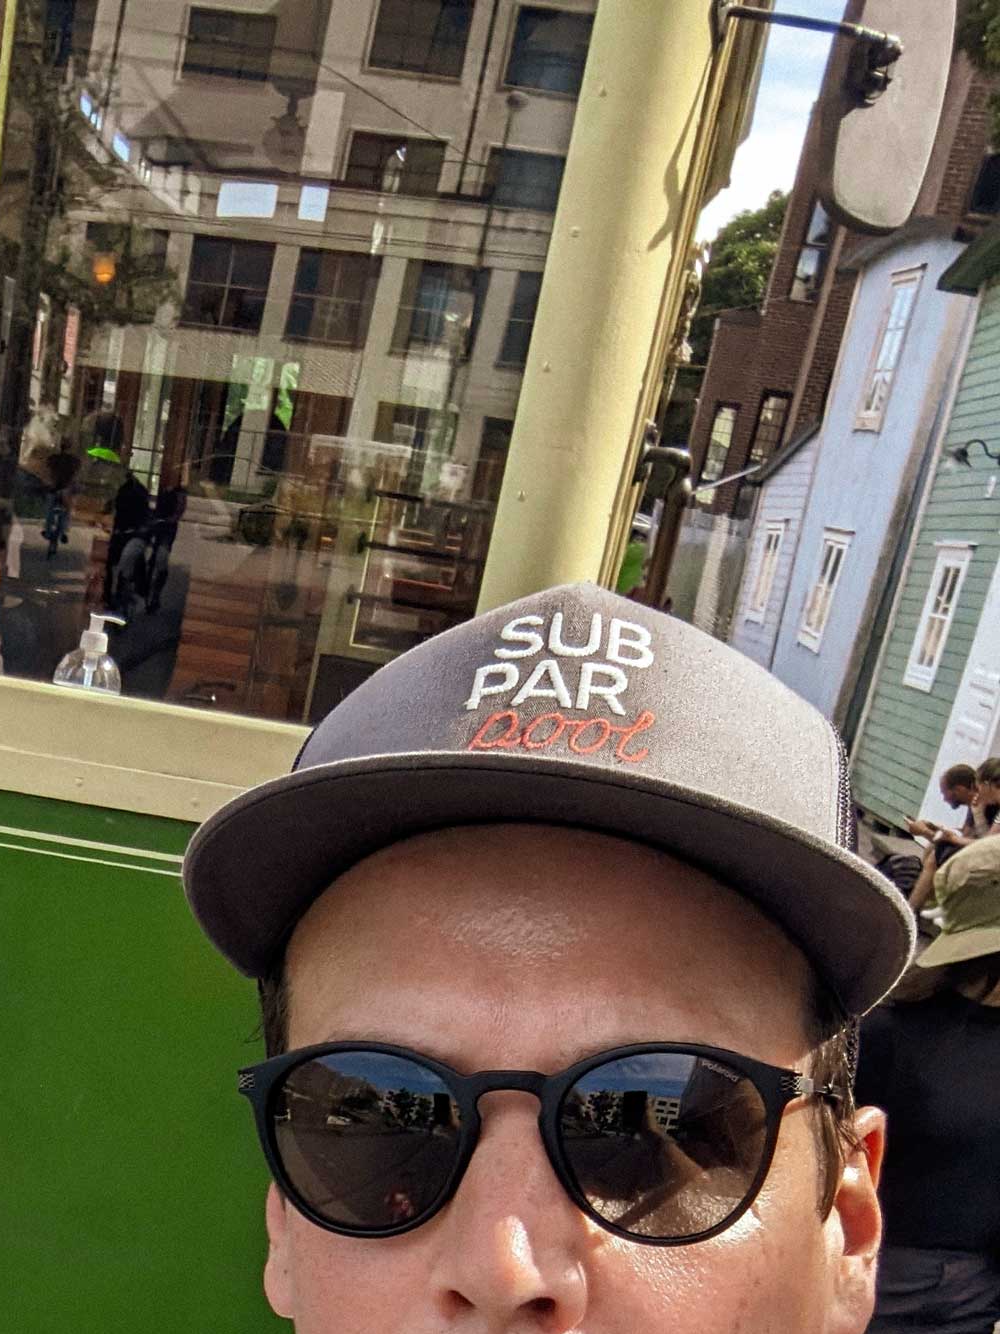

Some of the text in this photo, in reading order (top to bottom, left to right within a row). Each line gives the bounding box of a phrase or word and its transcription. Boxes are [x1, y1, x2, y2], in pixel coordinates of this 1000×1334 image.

[494, 612, 655, 669] SUB
[463, 659, 627, 716] PAR
[467, 709, 656, 763] pool
